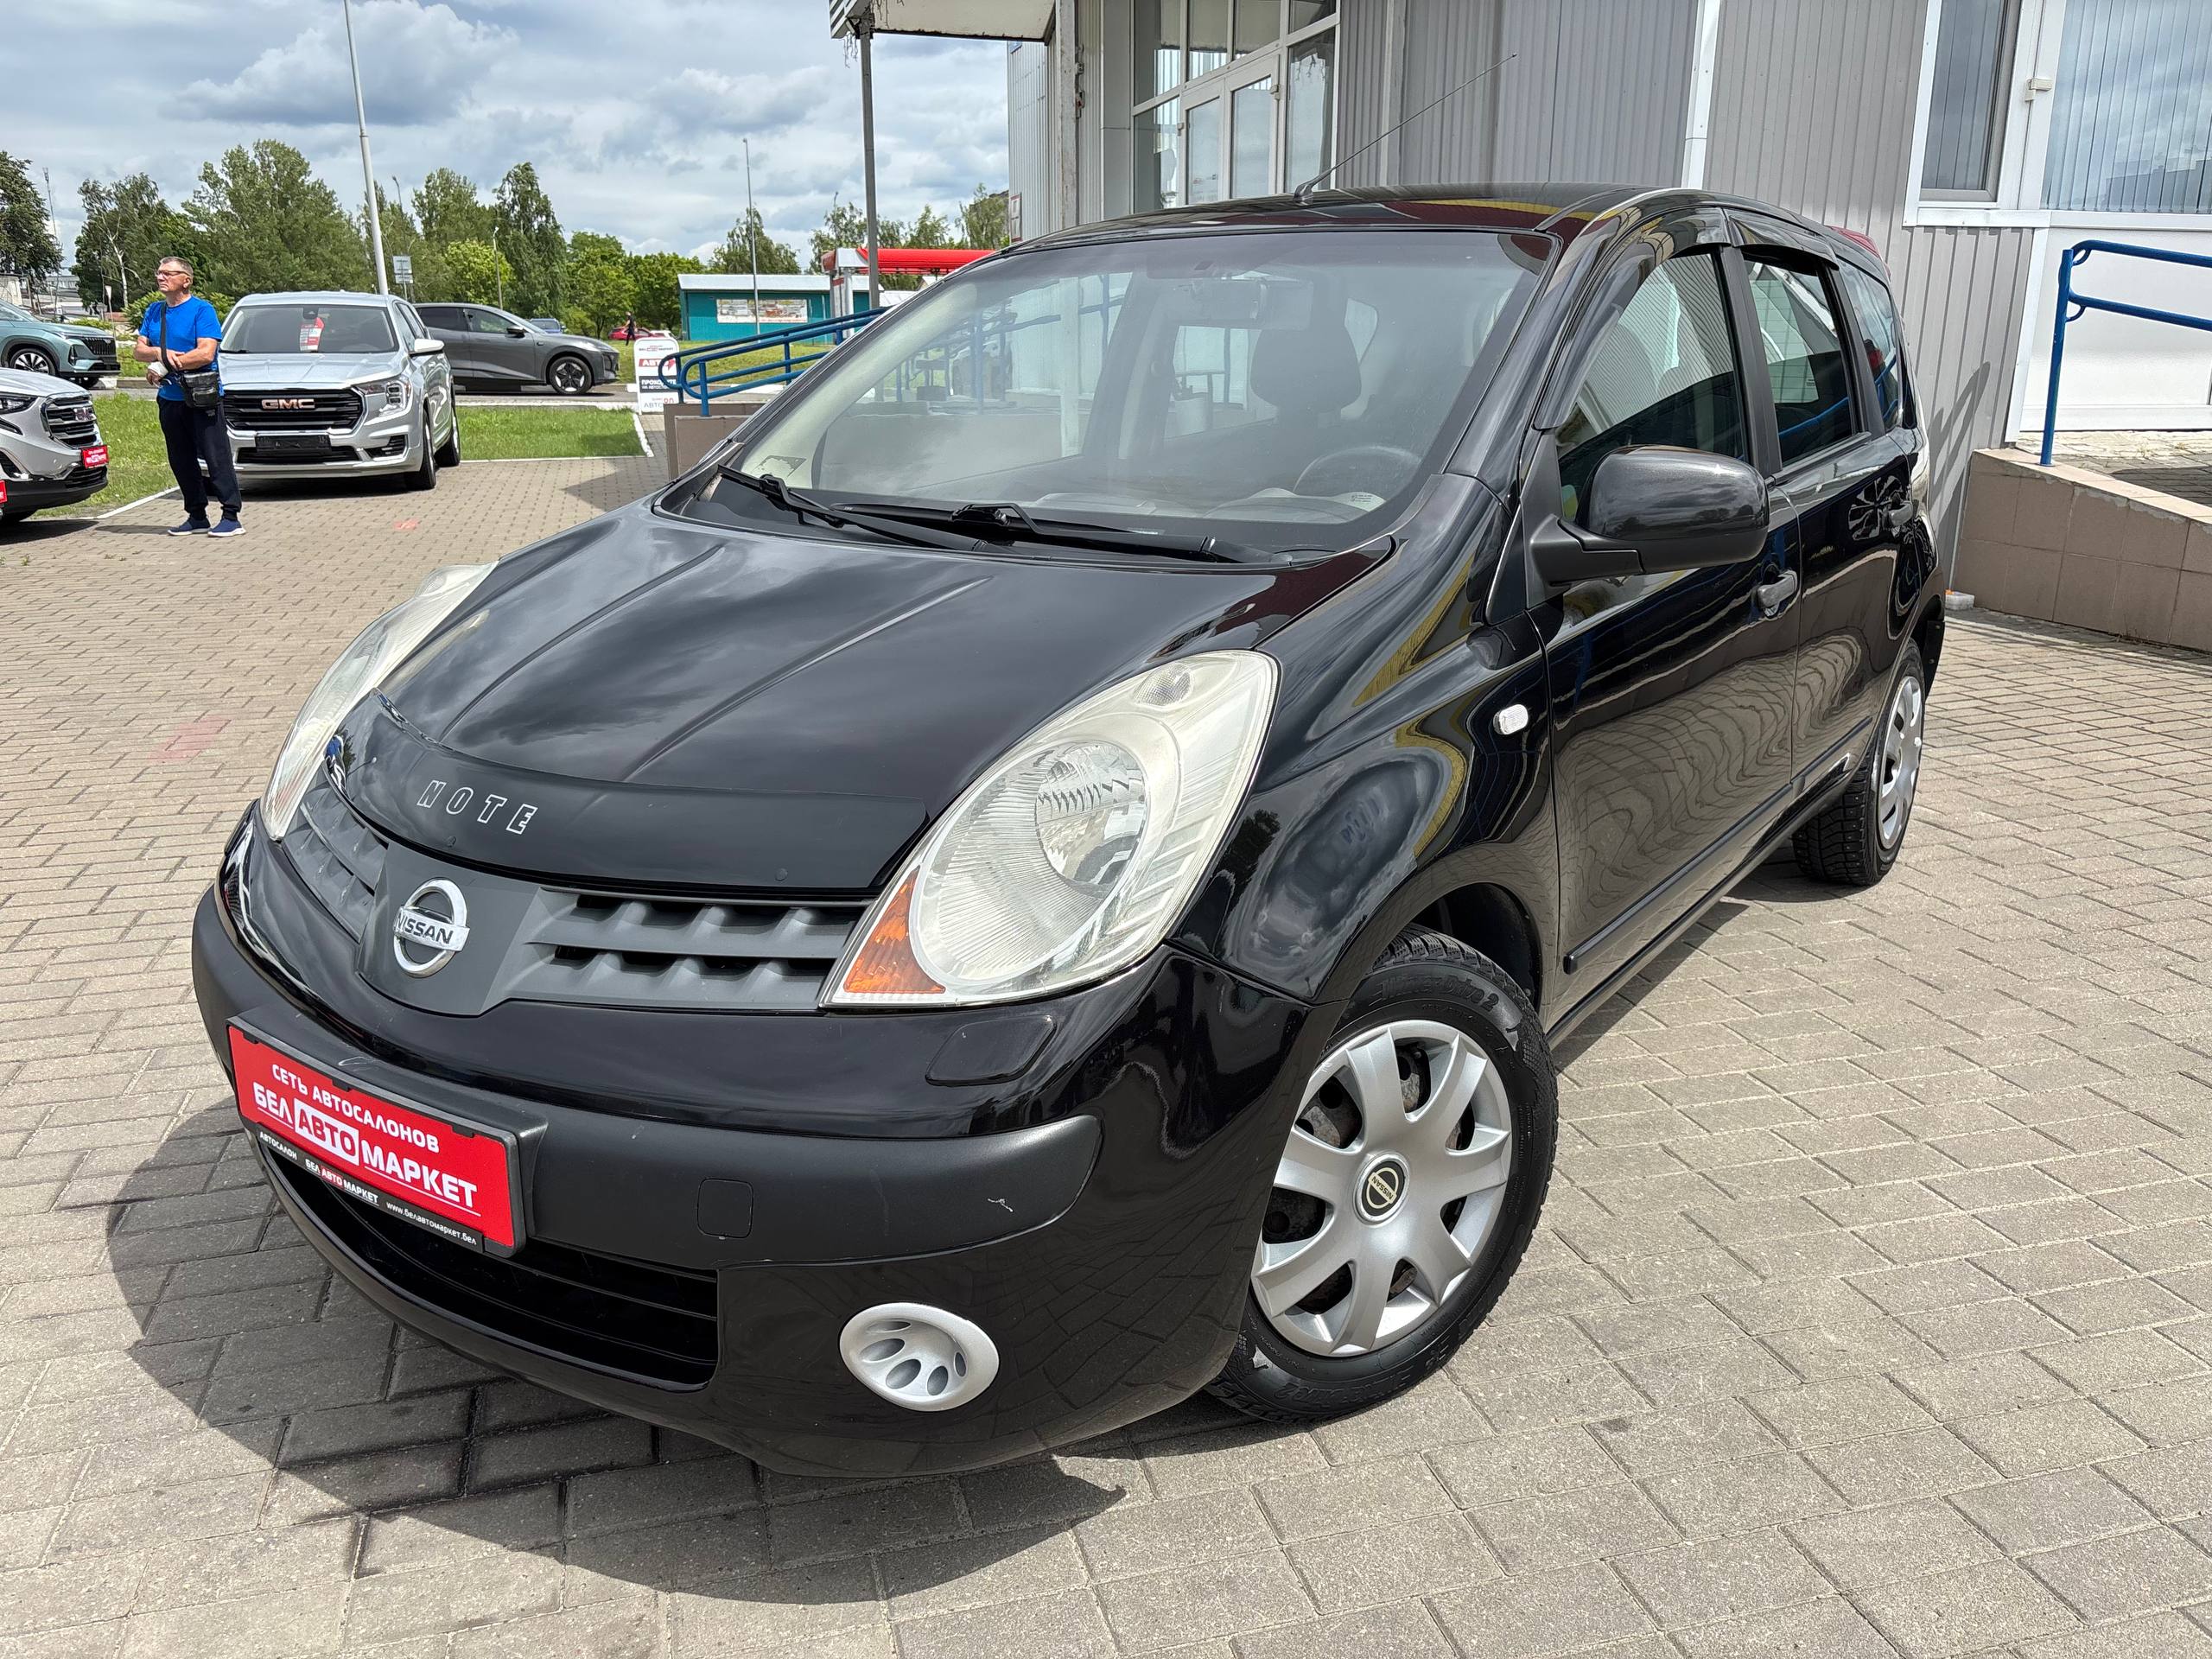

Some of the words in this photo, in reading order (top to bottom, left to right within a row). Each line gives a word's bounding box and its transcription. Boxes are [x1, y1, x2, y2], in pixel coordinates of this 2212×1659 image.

[261, 398, 315, 410] GMC
[416, 779, 538, 835] NOTE
[394, 912, 454, 945] NISSAN
[272, 1064, 308, 1096] СЕТЬ
[313, 1085, 440, 1154] АВТОСАЛОНОВ
[253, 1082, 293, 1124] БЕЛ
[298, 1108, 356, 1157] АВТО
[361, 1139, 478, 1209] МАРКЕТ
[259, 1131, 297, 1160] АВТОСАЛОН
[305, 1159, 321, 1173] БЕЛ
[321, 1168, 343, 1187] АВТО
[344, 1179, 379, 1204] МАРКЕТ
[386, 1202, 477, 1245] www.белавтомаркет.бел
[1370, 1176, 1394, 1200] NISSAN
